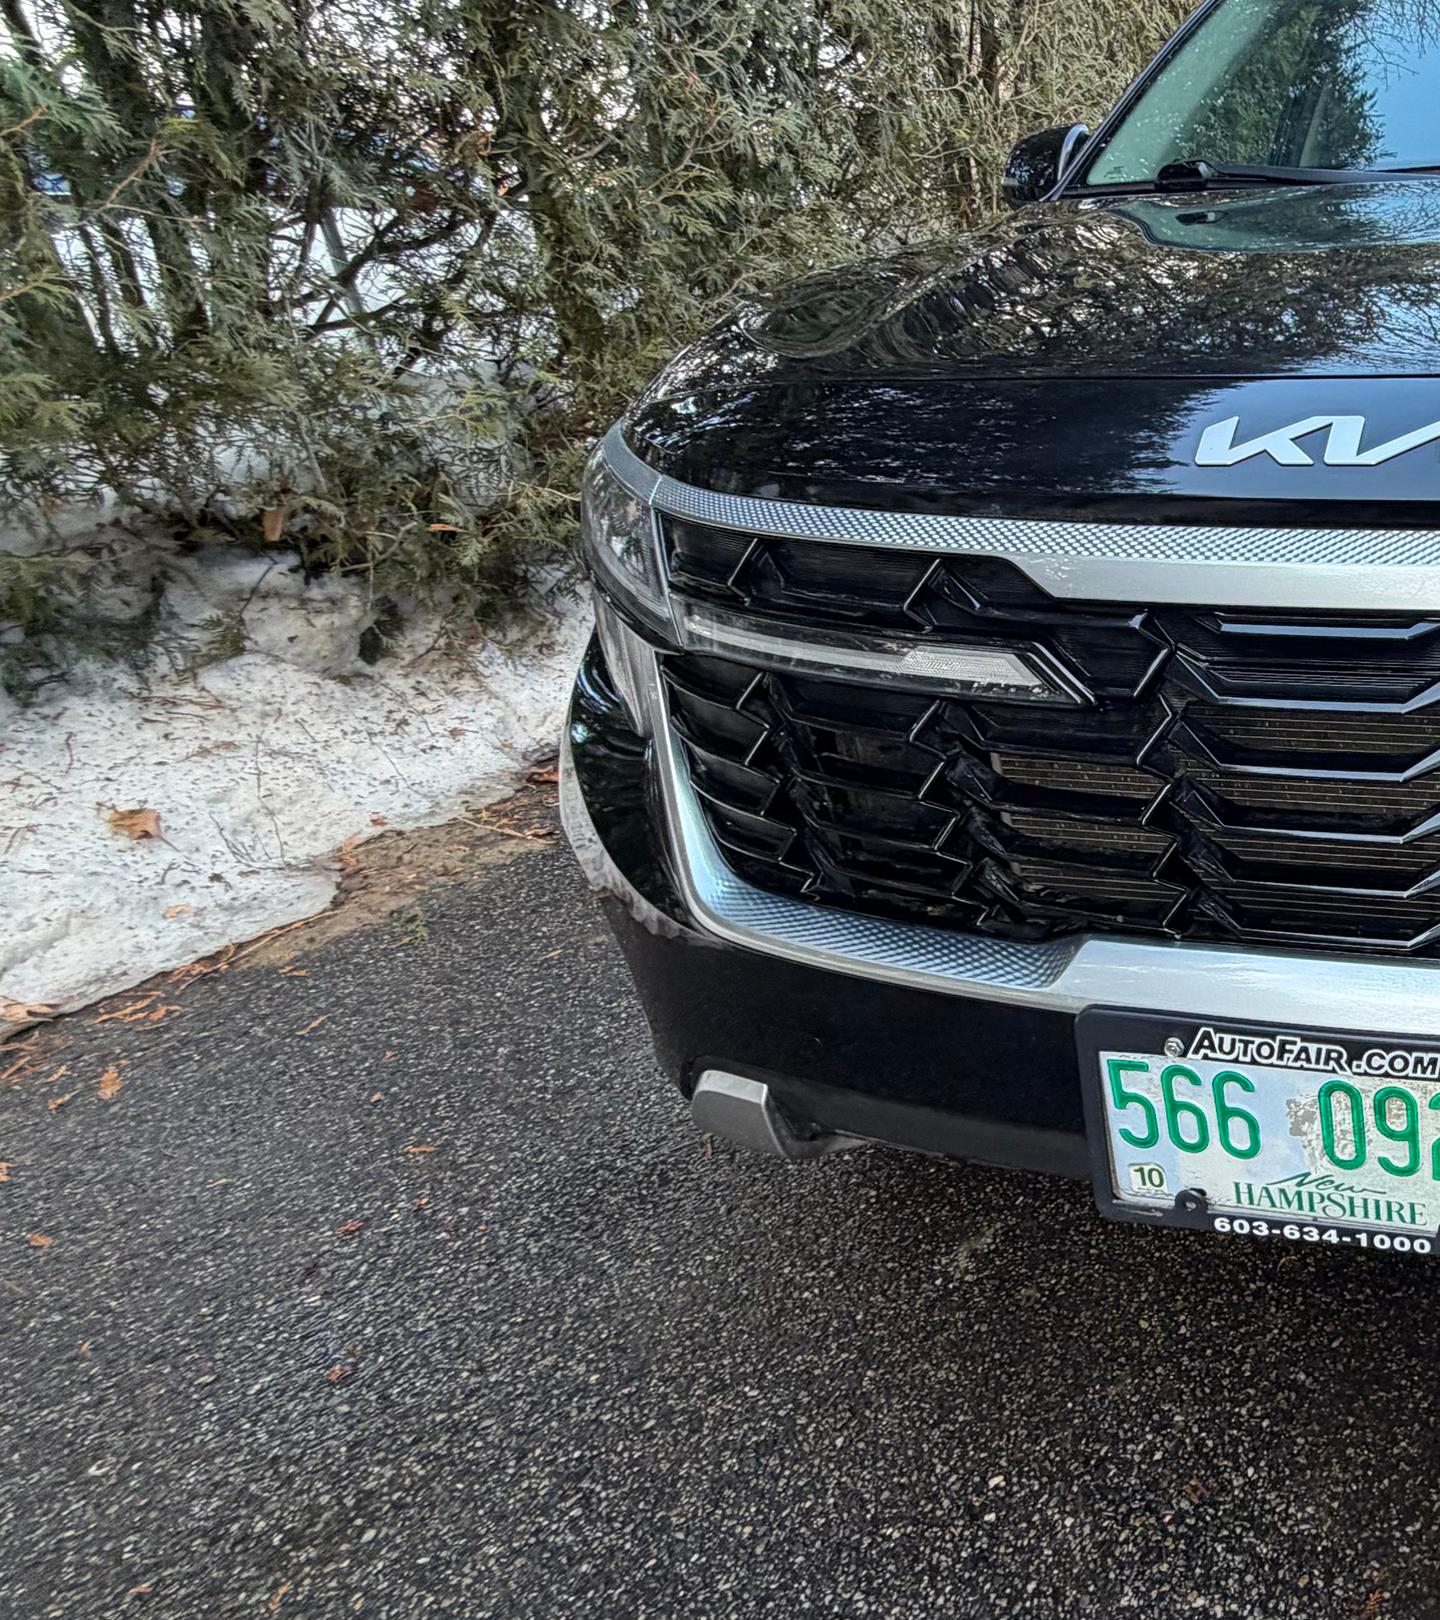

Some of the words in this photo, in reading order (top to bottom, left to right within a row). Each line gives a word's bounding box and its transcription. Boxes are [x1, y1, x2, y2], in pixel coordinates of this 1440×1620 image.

[1107, 1059, 1261, 1161] 566
[1133, 1166, 1165, 1188] 10
[1266, 1171, 1387, 1195] New
[1232, 1181, 1428, 1227] HAMPSHIRE
[1213, 1216, 1432, 1254] 603-634-1000
